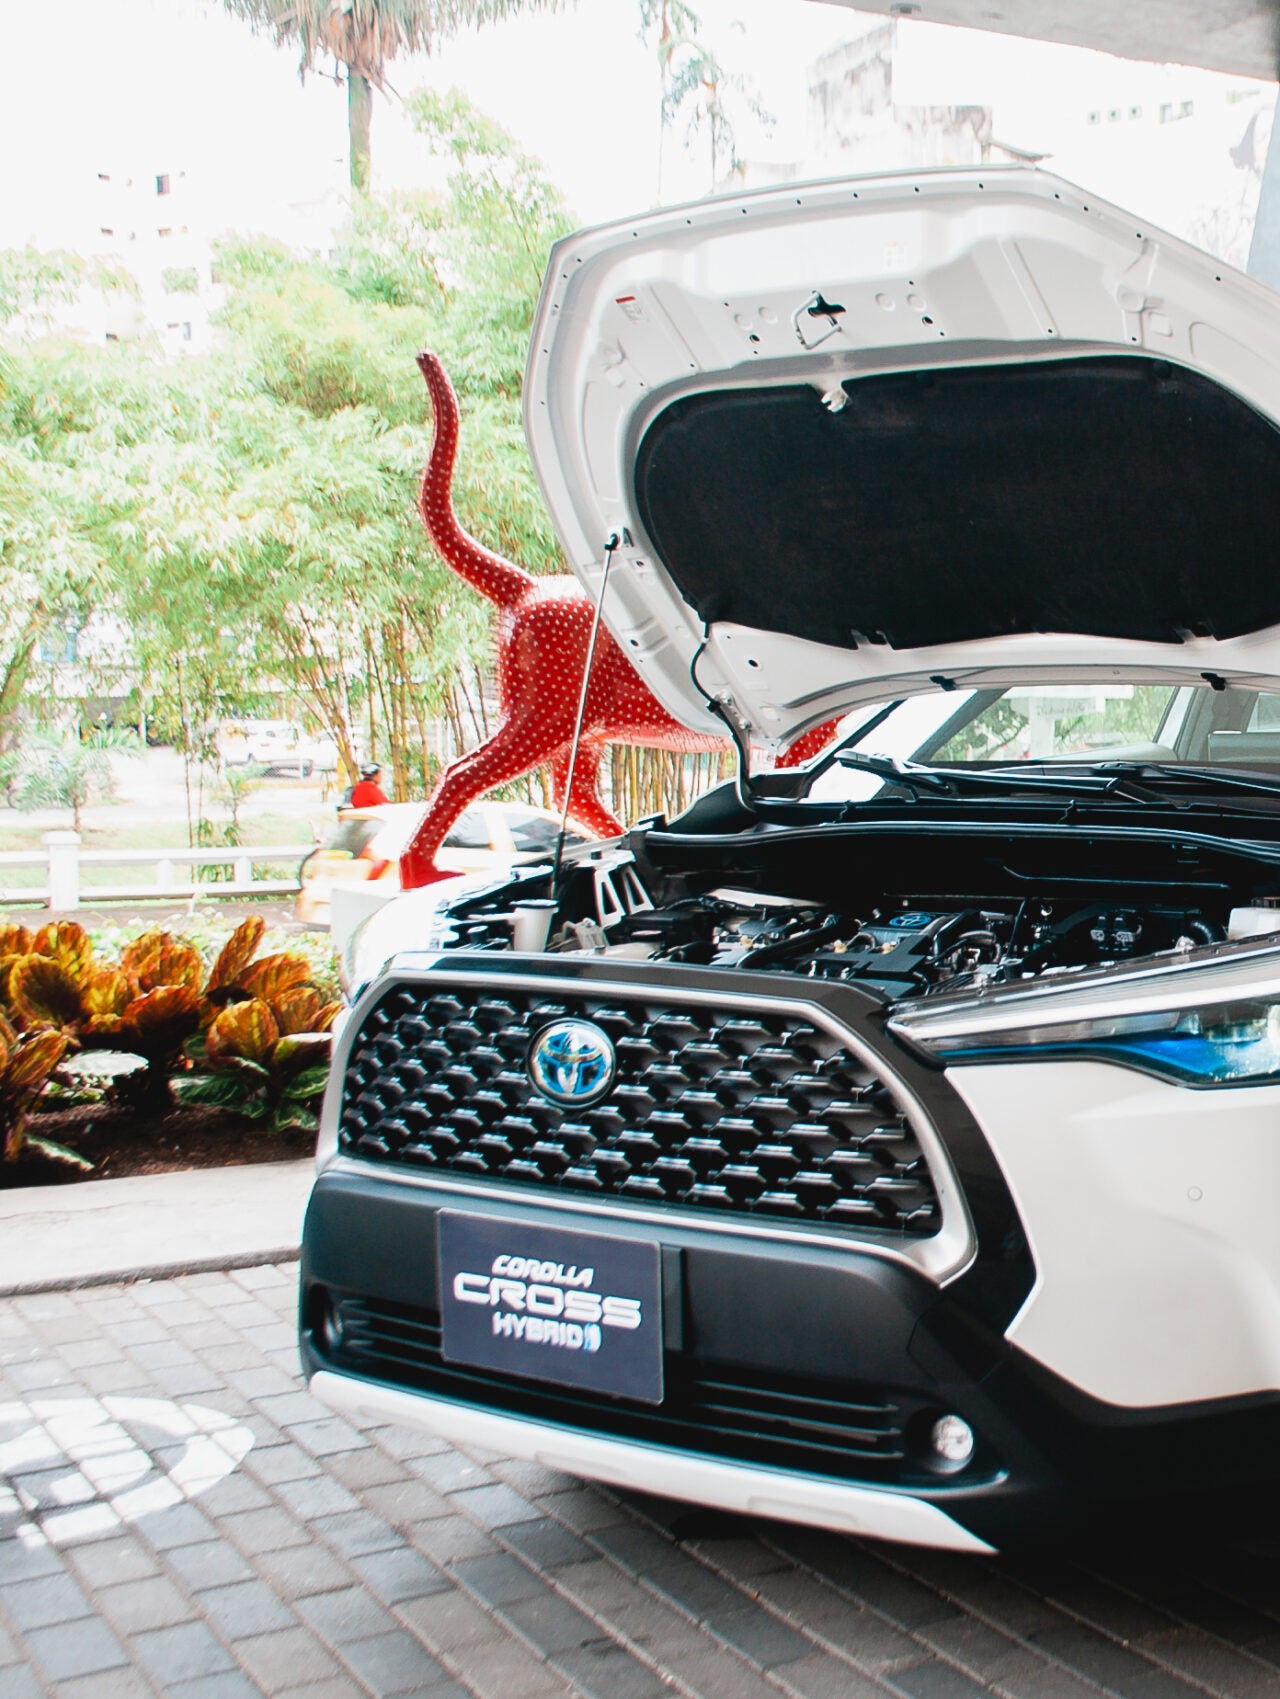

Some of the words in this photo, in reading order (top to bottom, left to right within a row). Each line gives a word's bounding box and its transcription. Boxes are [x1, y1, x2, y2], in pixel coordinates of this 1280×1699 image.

[491, 1254, 595, 1288] COROLLA
[453, 1272, 642, 1330] CROSS
[492, 1311, 584, 1350] HYBRID
